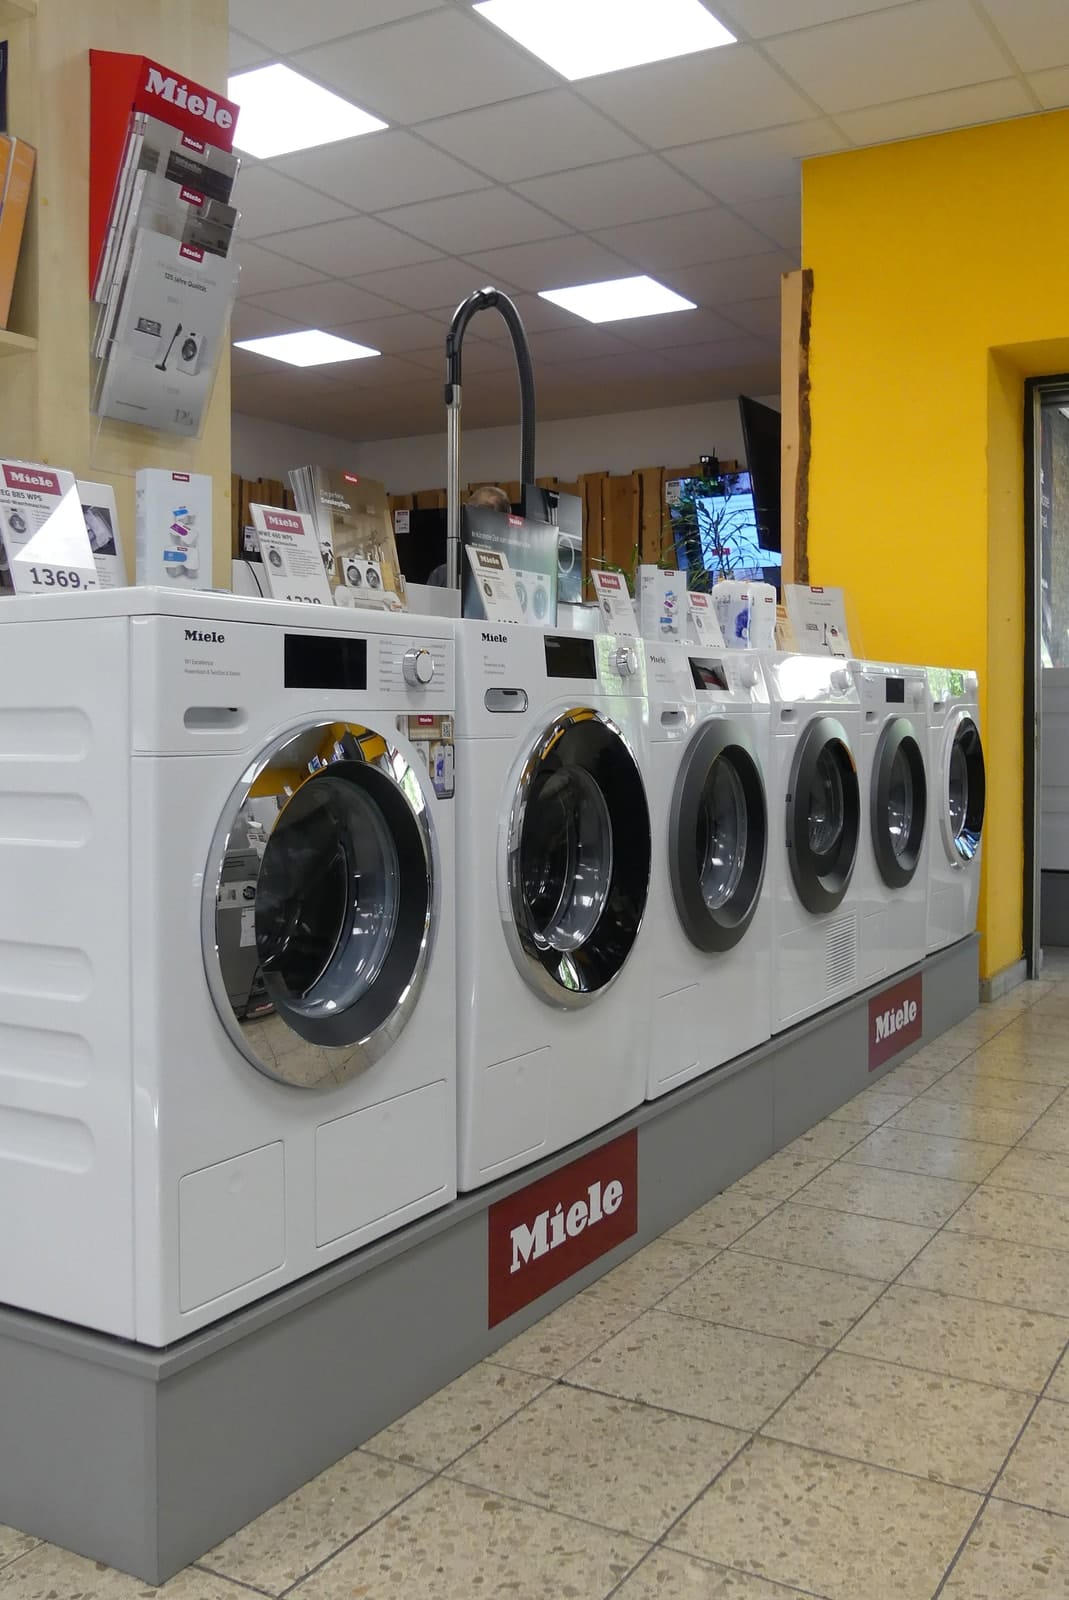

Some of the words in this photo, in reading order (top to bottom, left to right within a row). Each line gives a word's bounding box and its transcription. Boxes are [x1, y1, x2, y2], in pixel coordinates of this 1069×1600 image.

[145, 67, 233, 129] Miele
[183, 136, 203, 150] Miele
[182, 191, 202, 203] Miele
[181, 246, 202, 259] Miele
[10, 471, 54, 488] Miele
[26, 493, 42, 502] WPS
[268, 516, 300, 529] Miele
[480, 554, 500, 566] Miele
[30, 567, 96, 590] 1369,-
[184, 630, 224, 643] Miele
[481, 632, 507, 644] Miele
[875, 999, 918, 1044] Miele
[510, 1179, 623, 1273] Miele
